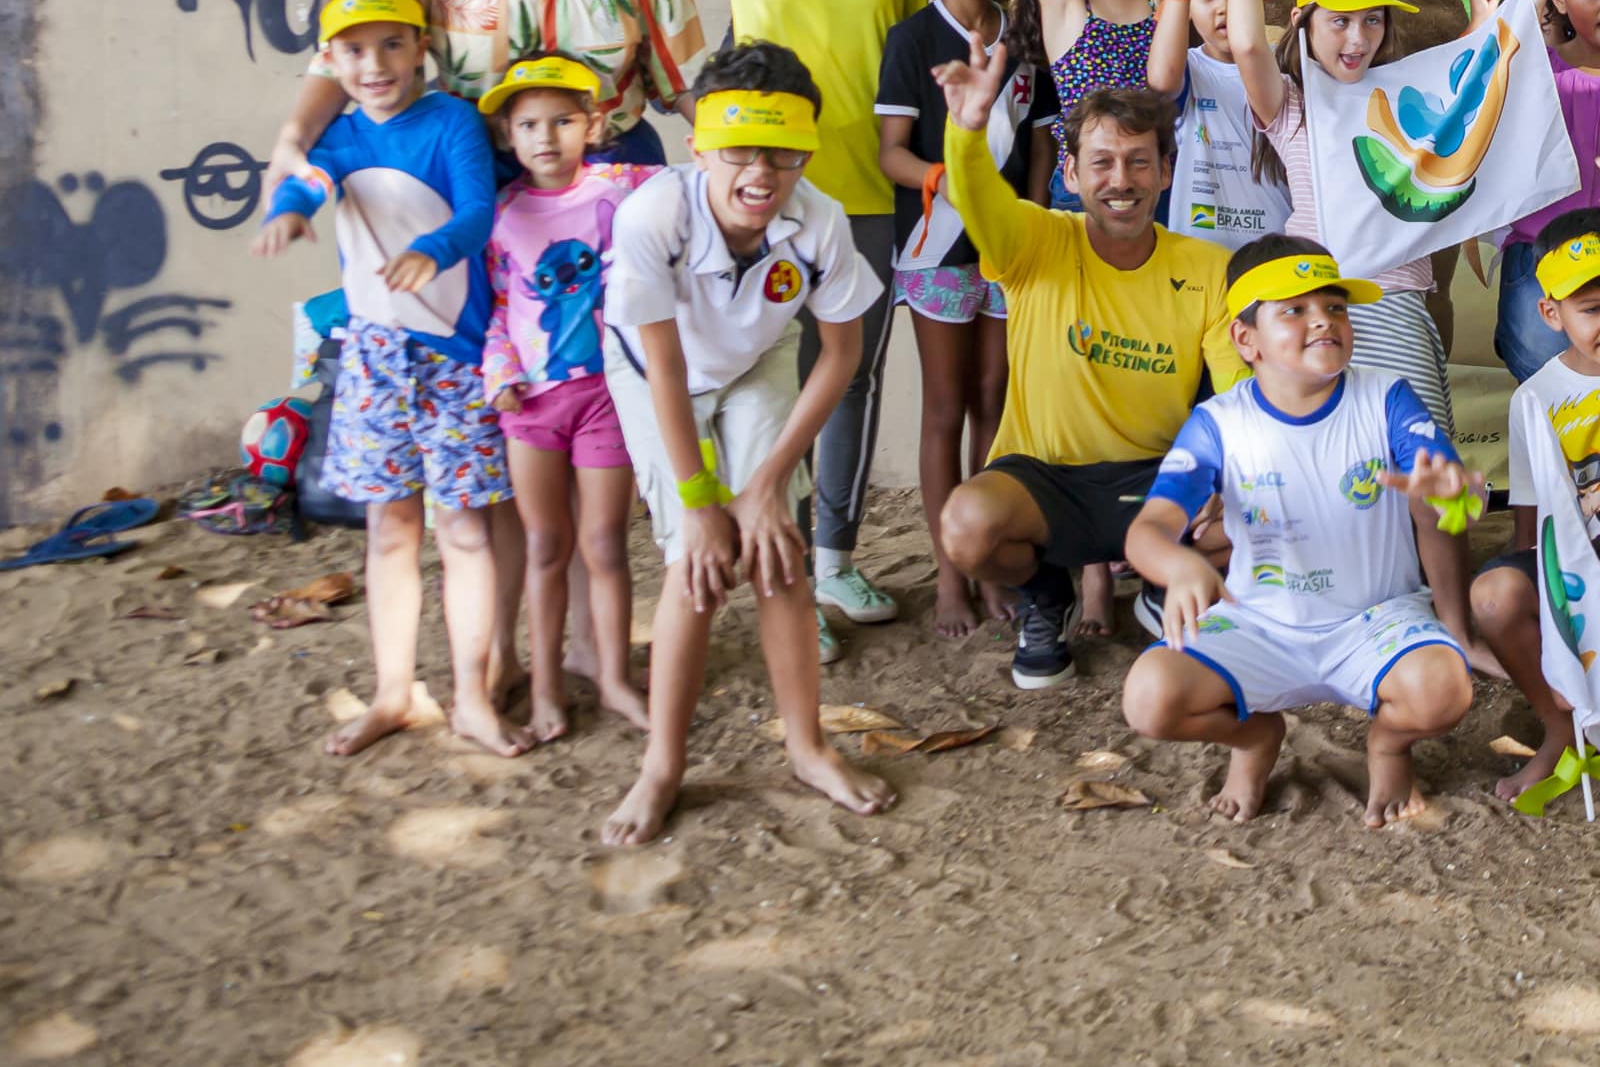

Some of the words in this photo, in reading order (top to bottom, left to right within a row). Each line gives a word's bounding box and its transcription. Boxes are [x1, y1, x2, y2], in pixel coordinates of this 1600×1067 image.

[1217, 213, 1266, 230] BRASIL
[1156, 343, 1174, 355] DA
[1088, 343, 1177, 374] RESTINGA
